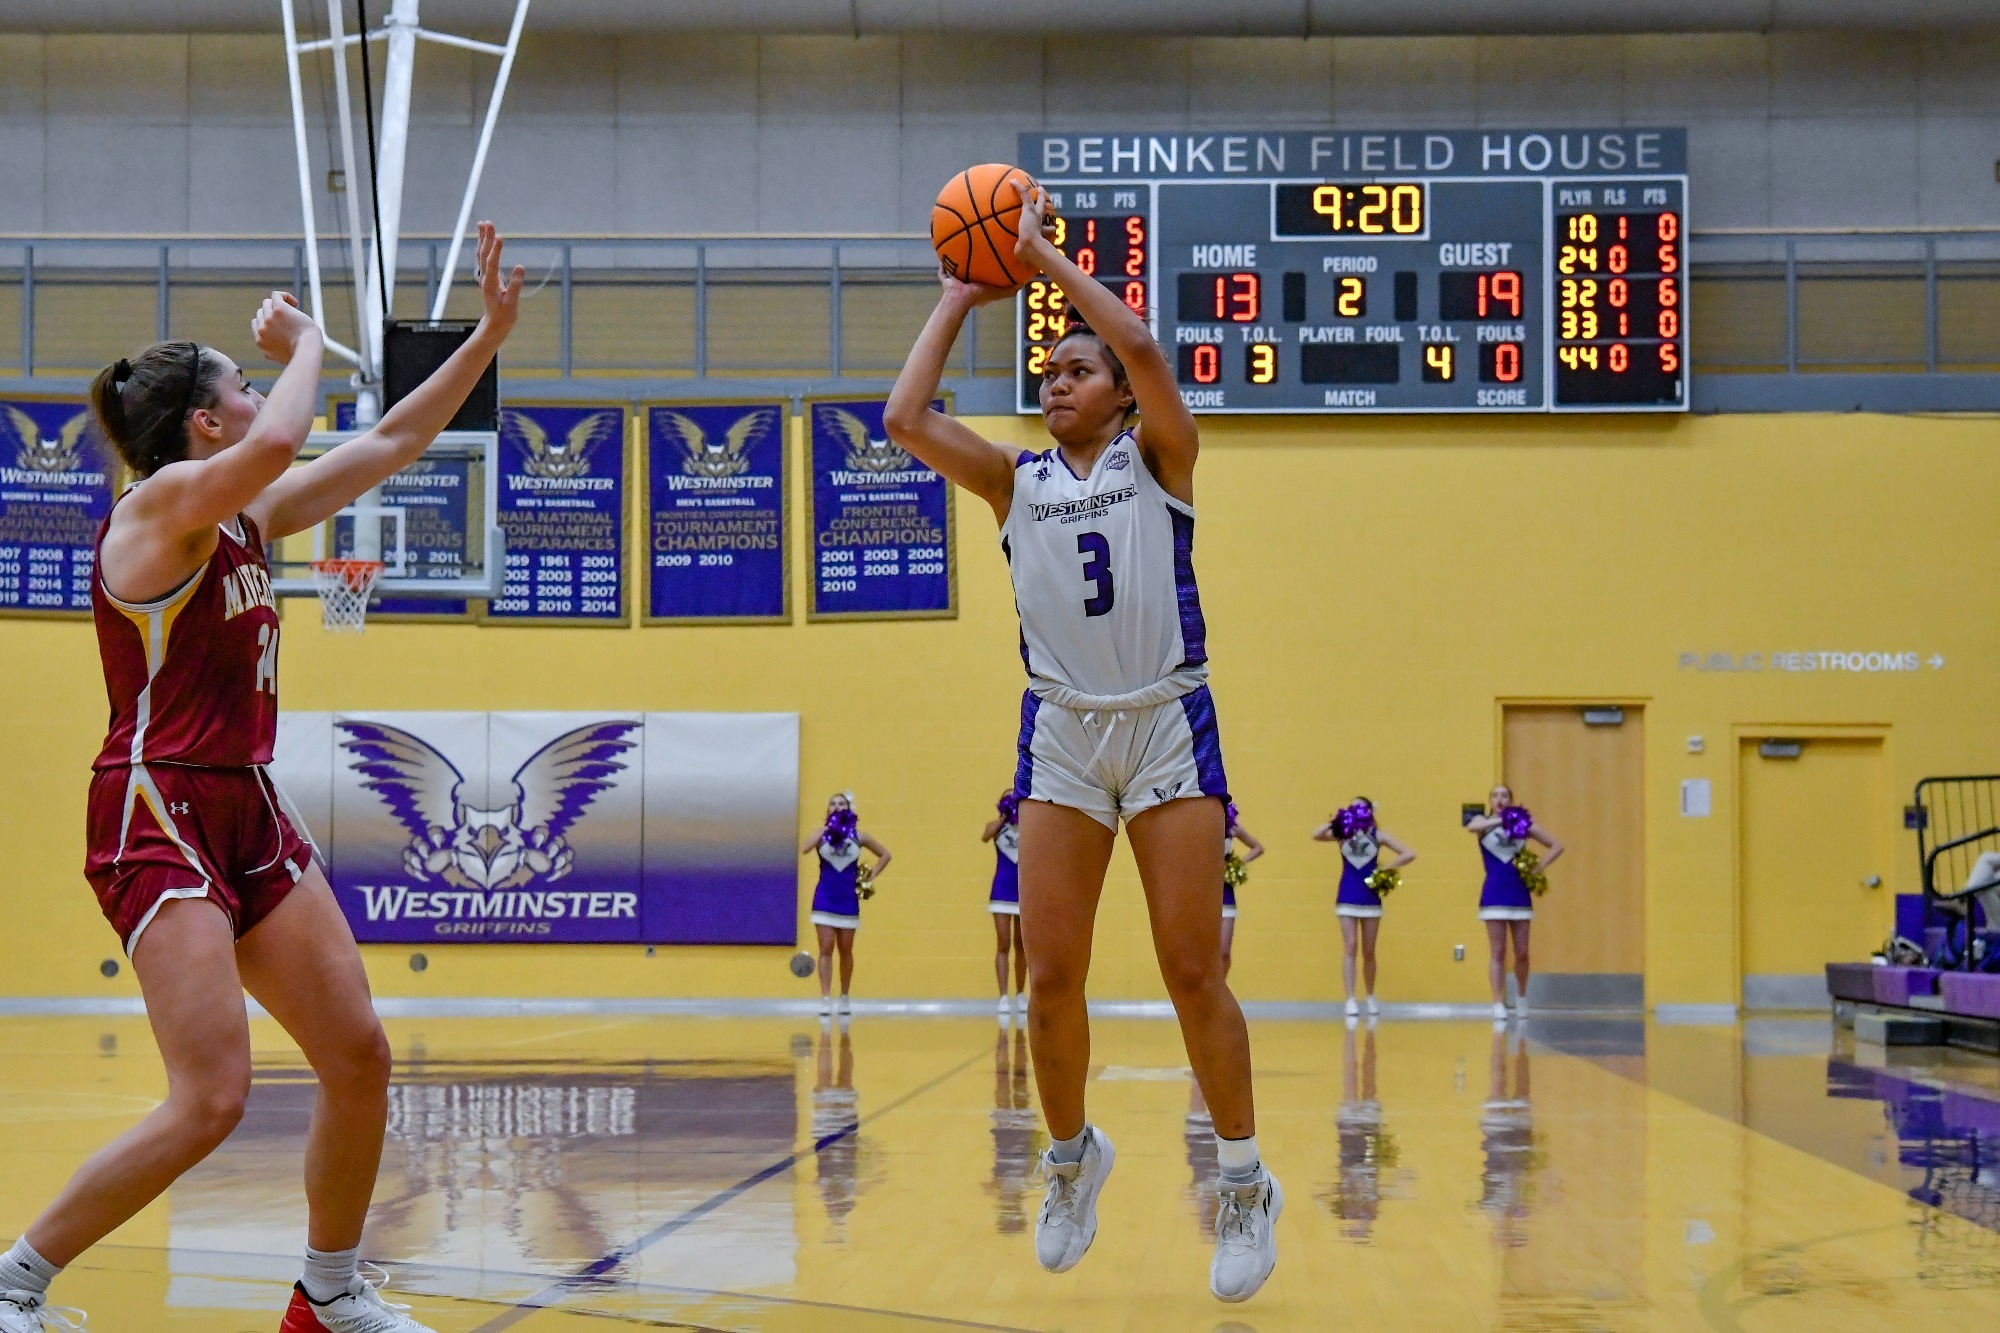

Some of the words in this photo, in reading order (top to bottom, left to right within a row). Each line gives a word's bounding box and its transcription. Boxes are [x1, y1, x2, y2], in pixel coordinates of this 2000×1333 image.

[1042, 137, 1286, 173] BEHNKEN
[1310, 135, 1454, 172] FIELD
[1482, 134, 1662, 171] HOUSE
[1075, 192, 1097, 209] FLS
[1113, 192, 1137, 209] PTS
[1559, 188, 1593, 206] PLYR
[1603, 188, 1626, 206] FLS
[1643, 188, 1668, 205] PTS
[1313, 185, 1420, 233] 9:20
[1087, 219, 1095, 243] 1
[1126, 217, 1144, 246] 5
[1569, 214, 1597, 243] 10
[1619, 216, 1627, 240] 1
[1658, 212, 1677, 242] 0
[1125, 248, 1144, 276] 2
[1192, 244, 1257, 268] HOME
[1439, 243, 1512, 266] GUEST
[1559, 245, 1598, 275] 24
[1608, 244, 1628, 274] 0
[1658, 244, 1677, 273] 5
[1322, 256, 1378, 273] PERIOD
[1028, 281, 1064, 310] 22
[1125, 281, 1144, 309] 0
[1215, 274, 1258, 321] 13
[1339, 278, 1362, 316] 2
[1477, 272, 1520, 318] 19
[1562, 279, 1598, 308] 32
[1608, 278, 1628, 307] 0
[1658, 278, 1677, 307] 6
[1028, 312, 1066, 341] 24
[1562, 310, 1598, 339] 33
[1619, 312, 1628, 336] 1
[1659, 309, 1677, 338] 0
[1175, 326, 1224, 343] FOULS
[1240, 326, 1282, 343] T.O.L.
[1298, 326, 1355, 343] PLAYER
[1365, 326, 1405, 343] FOUL
[1417, 326, 1460, 342] T.O.L.
[1476, 325, 1526, 341] FOULS
[1194, 344, 1217, 383] 0
[1252, 344, 1274, 383] 3
[1426, 346, 1451, 380] 4
[1495, 344, 1519, 382] 0
[1559, 346, 1598, 371] 44
[1609, 343, 1628, 373] 0
[1659, 343, 1678, 372] 5
[1324, 390, 1377, 407] MATCH
[1476, 389, 1526, 406] SCORE
[0, 467, 105, 485] WESTMINSTER
[507, 474, 614, 491] WESTMINSTER
[667, 475, 773, 491] WESTMINSTER
[830, 471, 938, 486] WESTMINSTER
[704, 498, 755, 508] BASKETBALL
[868, 491, 920, 502] BASKETBALL
[538, 511, 612, 524] NATIONAL
[842, 505, 918, 518] FRONTIER
[1060, 508, 1109, 525] GRIFFINS
[654, 521, 778, 535] TOURNAMENT
[830, 516, 930, 531] CONFERENCE
[655, 534, 778, 551] CHAMPIONS
[819, 528, 943, 547] CHAMPIONS
[581, 556, 615, 568] 2001
[656, 554, 692, 567] 2009
[699, 554, 734, 566] 2010
[821, 551, 854, 563] 2001
[863, 549, 899, 562] 2003
[907, 548, 944, 560] 2004
[537, 569, 572, 582] 2003
[581, 570, 617, 583] 2004
[821, 565, 857, 578] 2005
[863, 564, 900, 577] 2008
[907, 562, 944, 575] 2009
[1076, 531, 1115, 617] 3
[581, 585, 617, 598] 2007
[822, 580, 857, 593] 2010
[537, 600, 571, 612] 2010
[581, 601, 616, 613] 2014
[1679, 652, 1763, 672] PUBLIC
[1771, 651, 1920, 672] RESTROOMS
[353, 886, 638, 922] WESTMINSTER
[434, 921, 551, 935] GRIFFINS
